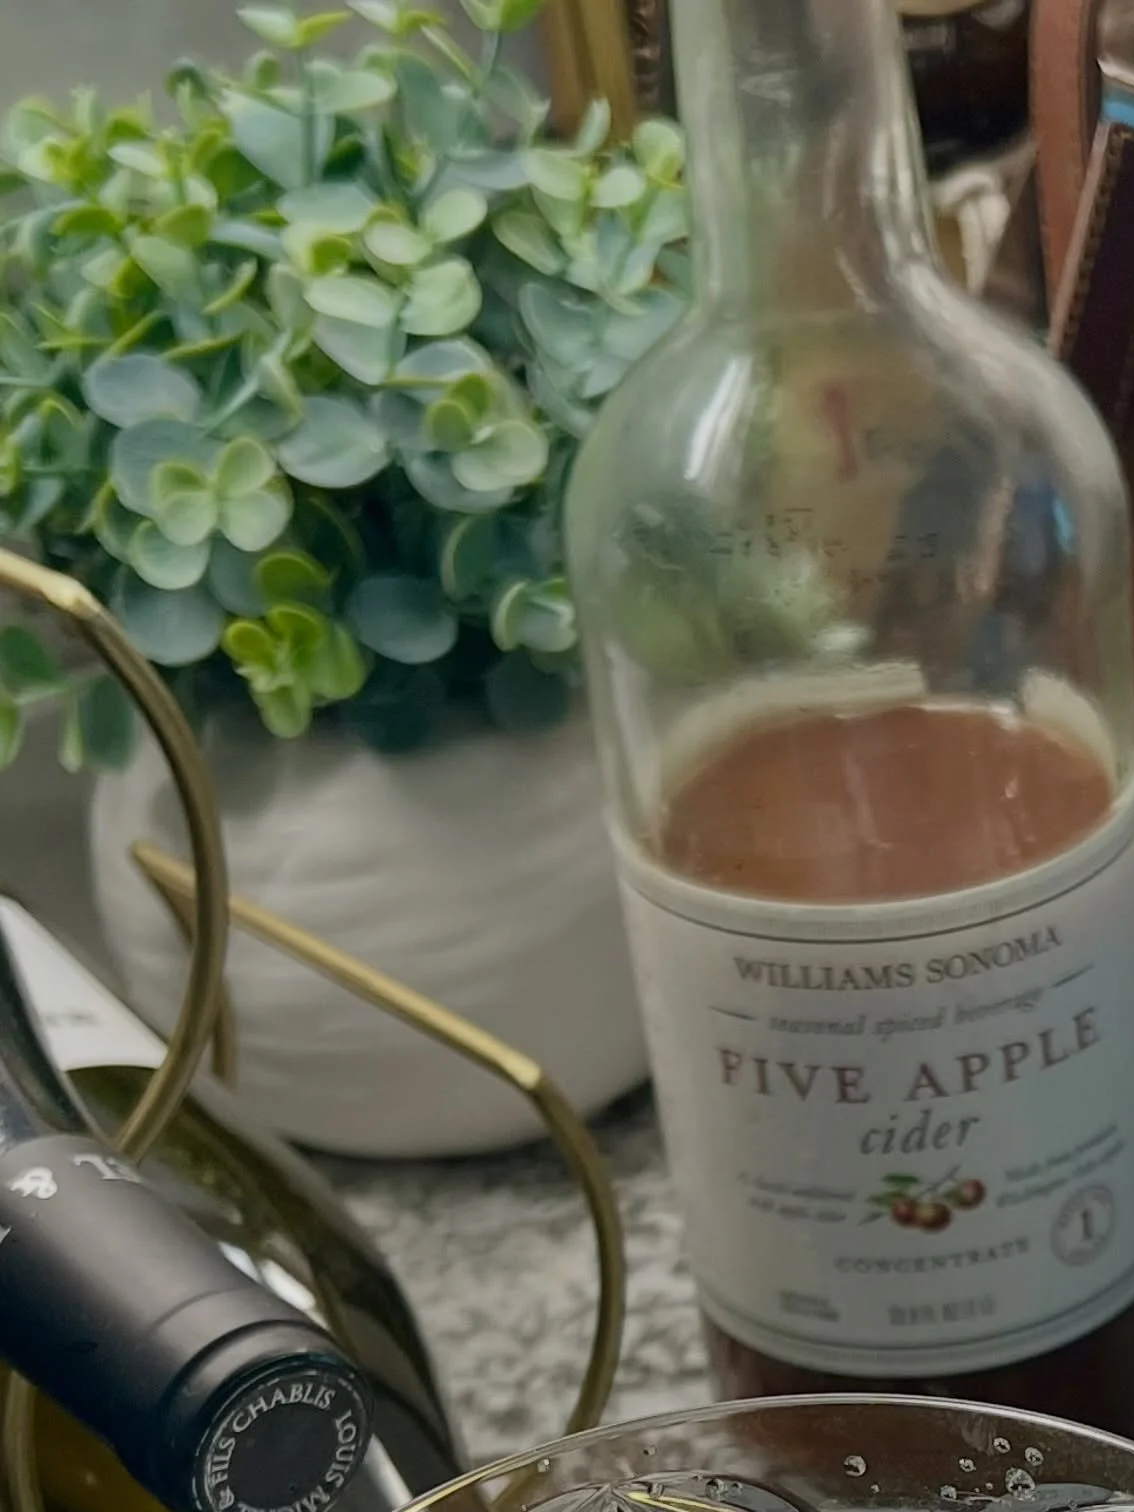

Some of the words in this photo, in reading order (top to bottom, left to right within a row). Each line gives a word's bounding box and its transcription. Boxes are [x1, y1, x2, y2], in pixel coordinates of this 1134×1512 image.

[733, 956, 916, 991] WILLIAMS
[926, 924, 1062, 983] SONOMA
[716, 1047, 872, 1104] FIVE
[904, 1006, 1102, 1102] APPLE
[859, 1107, 981, 1155] cider
[833, 1236, 1030, 1275] CONCENTRATE
[231, 1383, 337, 1433] CHABLIS
[211, 1436, 236, 1487] FILS
[324, 1408, 357, 1488] LOUIS
